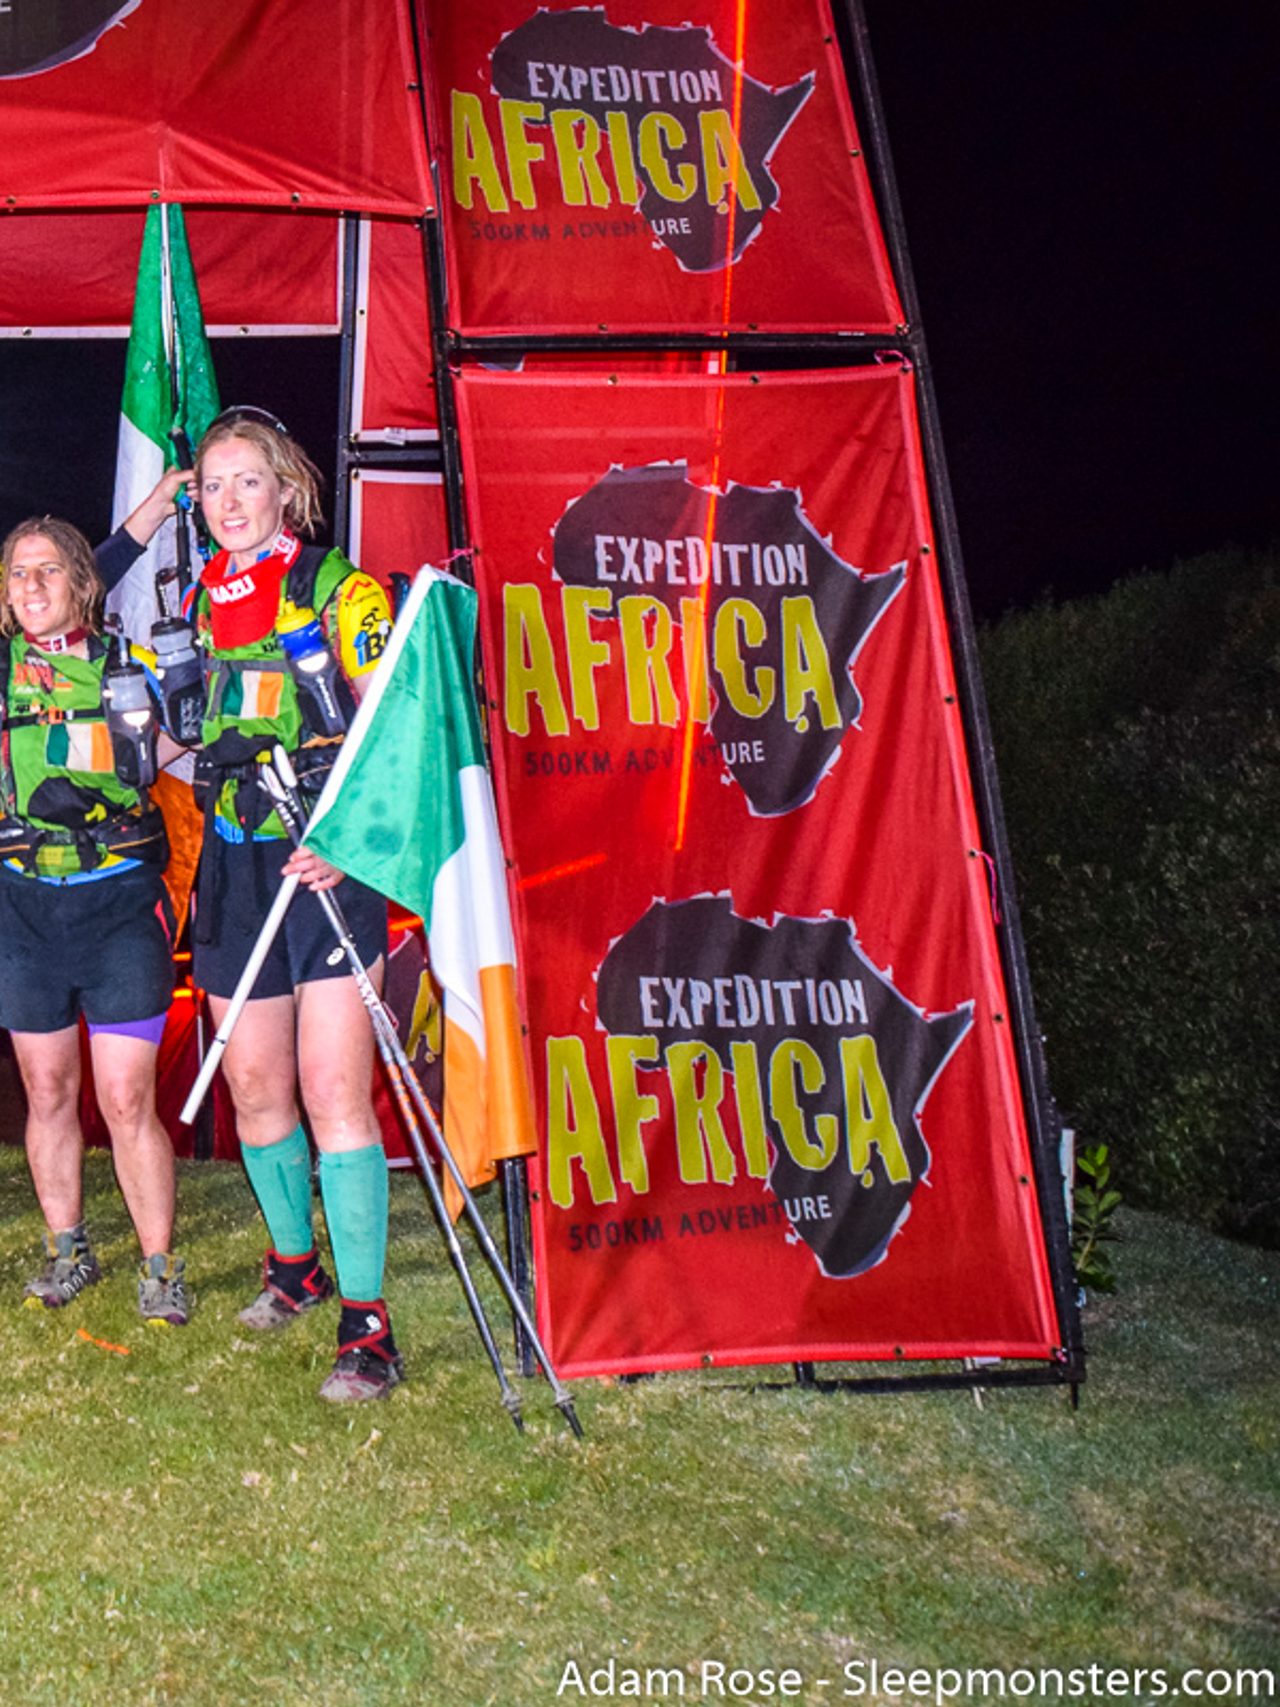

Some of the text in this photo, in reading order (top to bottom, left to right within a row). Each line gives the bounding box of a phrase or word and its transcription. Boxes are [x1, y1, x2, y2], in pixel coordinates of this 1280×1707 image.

[526, 61, 721, 103] EXPEDITION
[451, 90, 762, 213] AFRICA
[470, 216, 692, 242] 500KM ADVENTURE
[595, 534, 809, 587] EXPEDITION
[501, 581, 843, 737] AFRICA
[526, 740, 765, 776] 500KM ADVNTURE
[639, 975, 869, 1029] EXPEDITION
[546, 1034, 912, 1209] AFRICA
[569, 1195, 833, 1252] 500KM ADVENTURE
